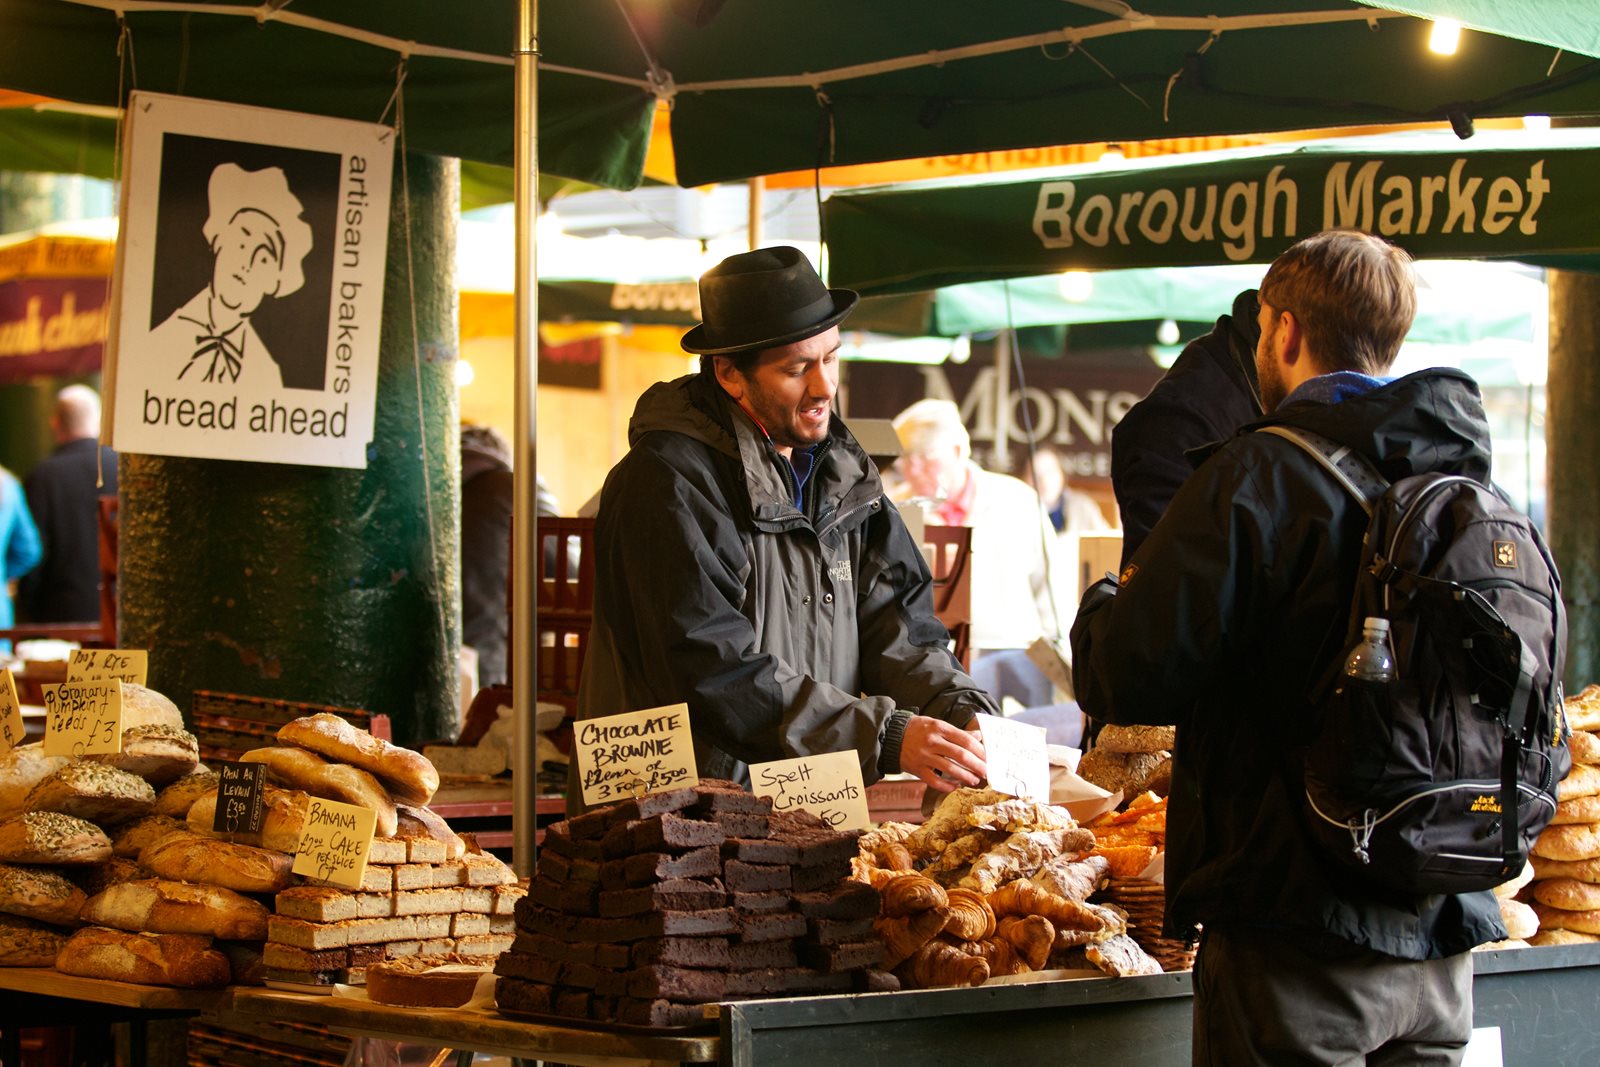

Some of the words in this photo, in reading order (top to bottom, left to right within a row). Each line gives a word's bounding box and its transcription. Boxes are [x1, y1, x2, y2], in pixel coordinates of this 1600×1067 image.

[342, 154, 369, 269] artisan
[1032, 165, 1298, 261] Borough
[1322, 158, 1550, 236] Market
[332, 281, 363, 395] bakers
[143, 389, 237, 430] bread
[249, 399, 349, 438] ahead
[58, 683, 108, 716] Granary
[86, 719, 117, 747] £3
[580, 713, 682, 745] CHOCOLATE
[592, 736, 674, 769] BROWNIE
[224, 783, 251, 798] LEVAIN
[597, 784, 612, 800] 3
[760, 763, 814, 794] Spelt
[774, 779, 859, 810] Croissants
[308, 802, 357, 831] BANANA
[330, 831, 363, 856] CAKE
[316, 851, 331, 865] PER
[332, 854, 356, 870] SLICE
